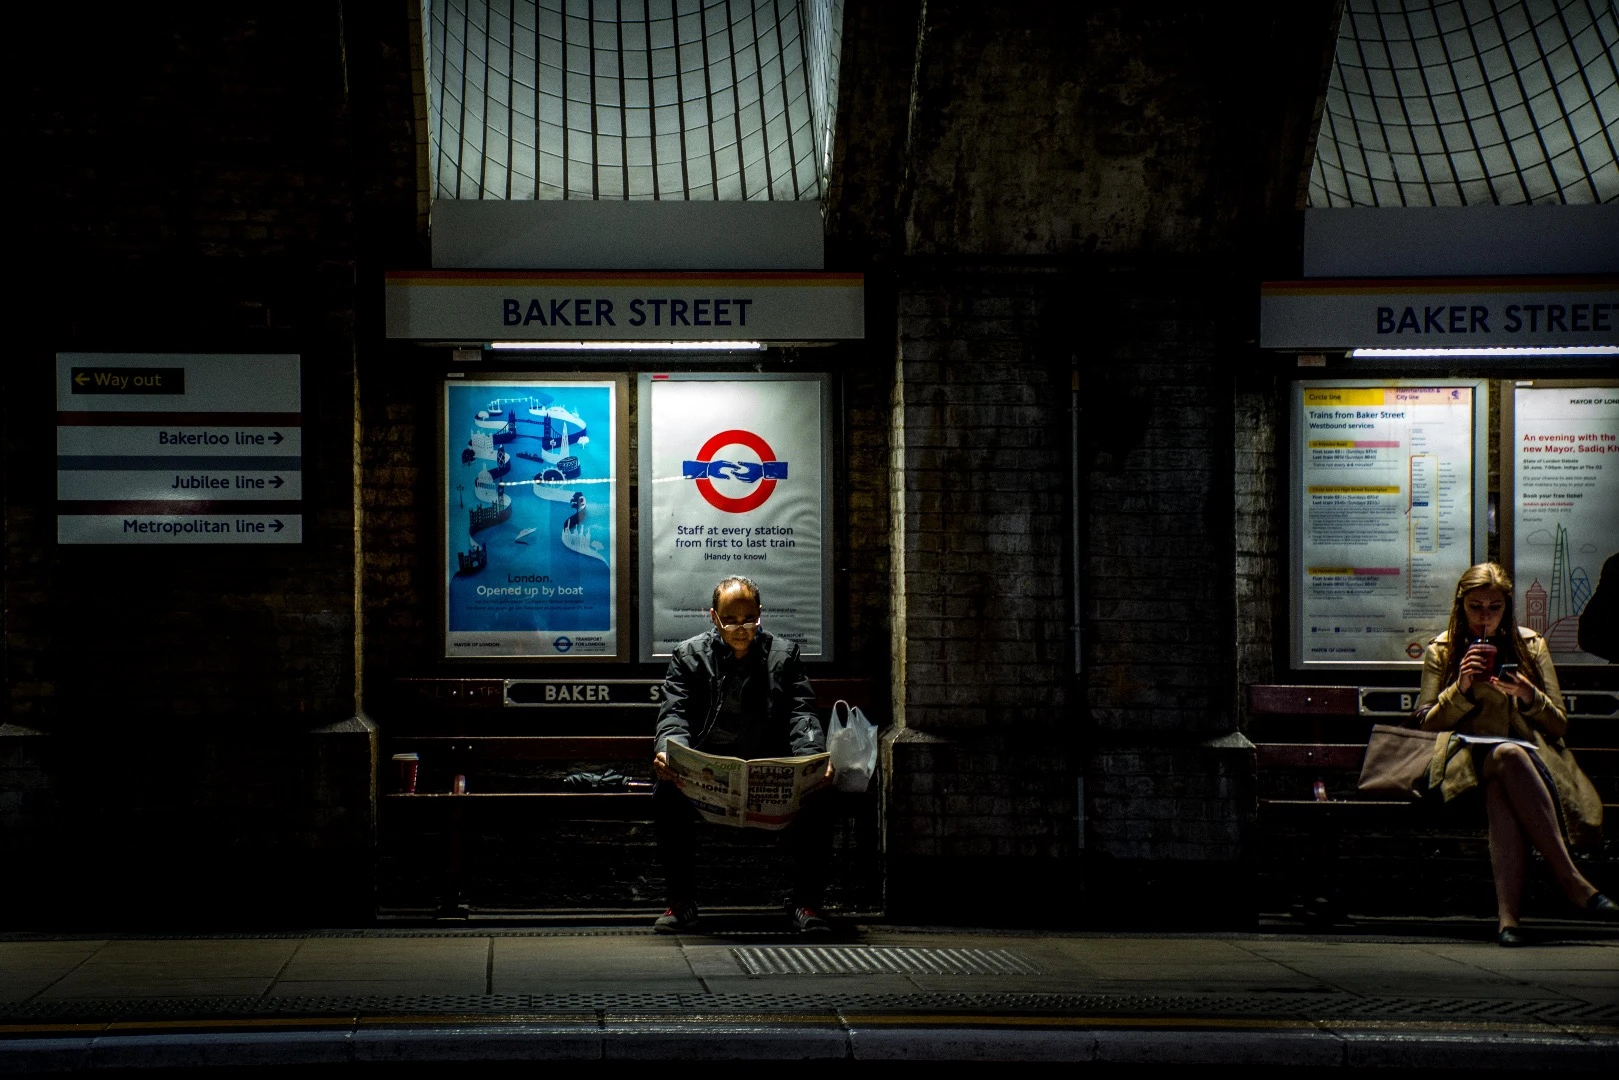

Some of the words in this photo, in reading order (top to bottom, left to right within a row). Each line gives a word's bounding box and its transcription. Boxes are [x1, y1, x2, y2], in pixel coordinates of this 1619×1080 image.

[503, 298, 616, 326] BAKER
[629, 298, 752, 326] STREET
[1377, 306, 1491, 334] BAKER
[93, 372, 128, 389] Way
[133, 373, 162, 386] out
[1309, 411, 1333, 419] Trains
[1335, 411, 1353, 419] from
[1356, 411, 1378, 419] Baker
[1380, 411, 1405, 419] Street
[159, 431, 229, 445] Bakerloo
[236, 431, 265, 445] line
[1523, 434, 1536, 442] An
[1538, 434, 1575, 443] evening
[1578, 434, 1598, 442] with
[1600, 434, 1616, 442] the
[1545, 445, 1576, 455] Mayor,
[1578, 445, 1605, 454] Sadiq
[171, 475, 229, 489] Jubilee
[236, 475, 265, 489] line
[123, 519, 230, 536] Metropolitan
[236, 519, 265, 533] line
[677, 525, 705, 535] Staff
[707, 526, 719, 535] at
[721, 527, 751, 537] every
[754, 525, 794, 535] station
[675, 538, 702, 548] from
[705, 538, 728, 548] first
[731, 539, 743, 548] to
[746, 538, 767, 548] last
[770, 538, 796, 548] train
[704, 553, 731, 562] (Handy
[743, 553, 767, 561] know)
[507, 573, 553, 583] London.
[476, 585, 522, 598] Opened
[525, 587, 539, 598] up
[542, 585, 555, 597] by
[558, 585, 584, 596] boat
[545, 685, 610, 702] BAKER
[751, 767, 794, 775] METRO
